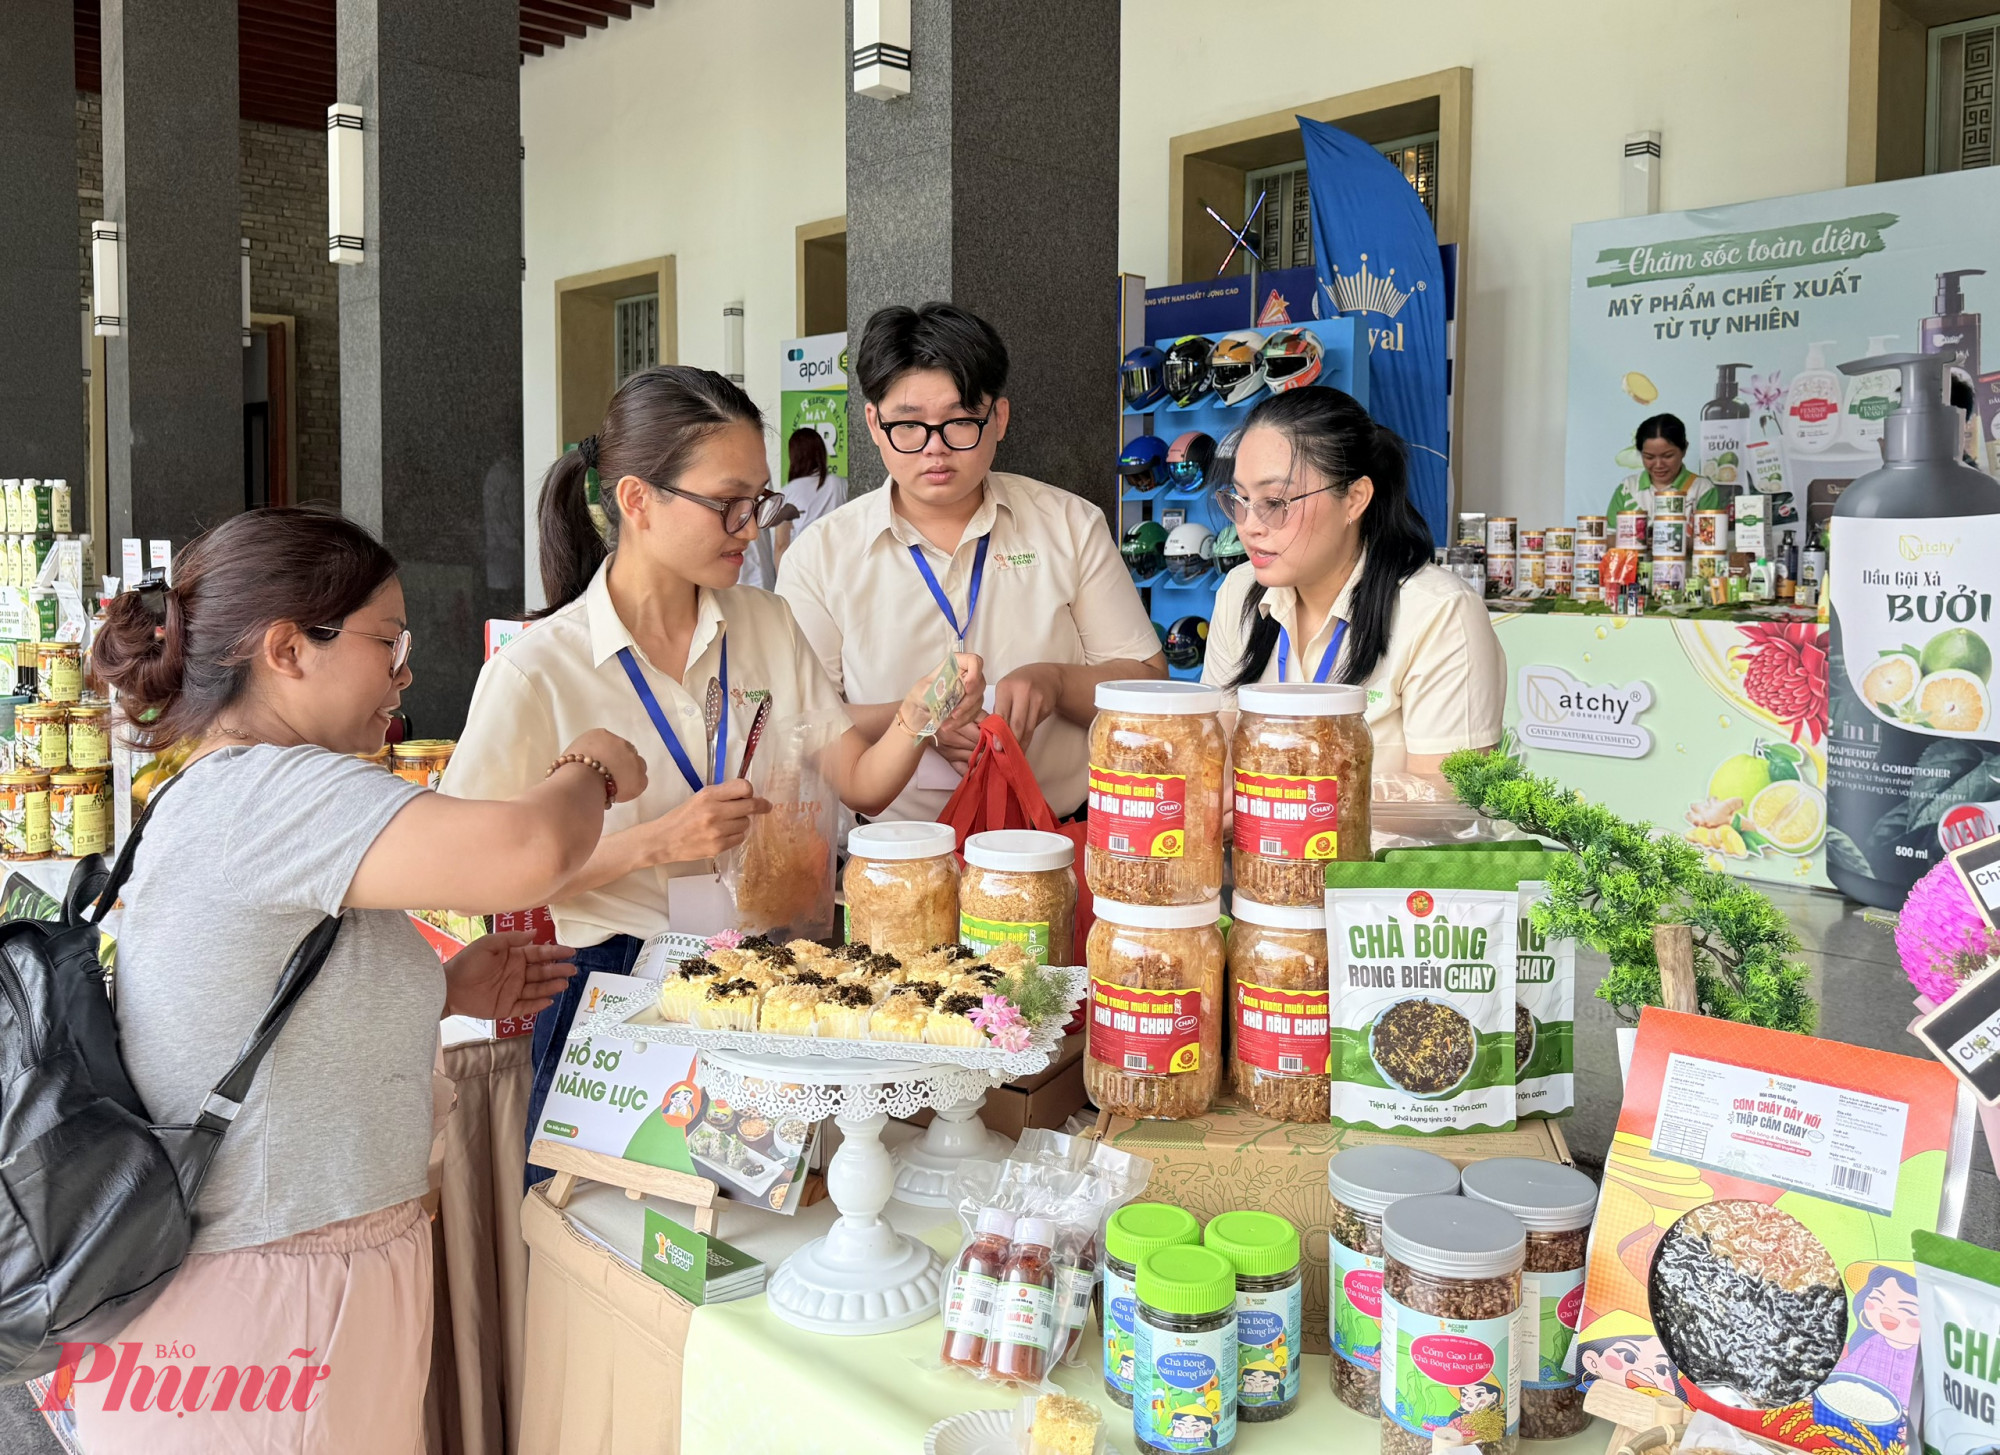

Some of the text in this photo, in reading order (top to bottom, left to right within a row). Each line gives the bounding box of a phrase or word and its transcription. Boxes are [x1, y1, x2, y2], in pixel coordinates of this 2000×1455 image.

[1628, 224, 1870, 276] Chăm sóc toàn diện
[1607, 267, 1862, 317] MỸ PHẨM CHIẾT XUẤT
[1653, 306, 1800, 341] TỪ TỰ NHIÊN
[799, 357, 833, 383] apoil
[1862, 568, 1890, 586] Dầu
[1895, 571, 1918, 589] Gội
[1887, 584, 1992, 623] BƯỞI
[1561, 731, 1593, 739] NATURAL
[1595, 734, 1636, 745] COSMETIC
[1881, 763, 1951, 779] CONDITIONER
[1122, 799, 1155, 819] CHAY
[1160, 803, 1178, 812] CHAY
[1273, 801, 1307, 821] CHAY
[1312, 805, 1331, 814] CHAY
[1942, 815, 1993, 849] NEW
[1895, 846, 1928, 860] 500 ml
[1348, 915, 1488, 960] CHÀ BÔNG
[1348, 960, 1493, 991] RONG BIỂN CHAY
[1140, 1017, 1173, 1035] CHAY
[1177, 1018, 1194, 1028] CHAY
[1243, 1009, 1263, 1030] KHÔ
[1294, 1018, 1328, 1036] CHAY
[564, 1036, 622, 1072] HỒ SƠ
[554, 1071, 649, 1113] NĂNG LỰC
[1532, 1089, 1548, 1099] cơm
[1733, 1098, 1755, 1111] CƠM
[1756, 1100, 1782, 1116] CHÁY
[1783, 1106, 1804, 1122] ĐÁY
[1736, 1111, 1759, 1128] THẬP
[1783, 1122, 1808, 1139] CHAY
[666, 1244, 693, 1264] ACCNHI
[672, 1254, 689, 1270] FOOD
[1421, 1345, 1444, 1357] Cốm
[1183, 1359, 1207, 1369] Bông
[1429, 1358, 1452, 1371] Bông
[1452, 1361, 1475, 1373] Rong
[1177, 1369, 1199, 1381] Rong
[1943, 1371, 1995, 1425] RONG
